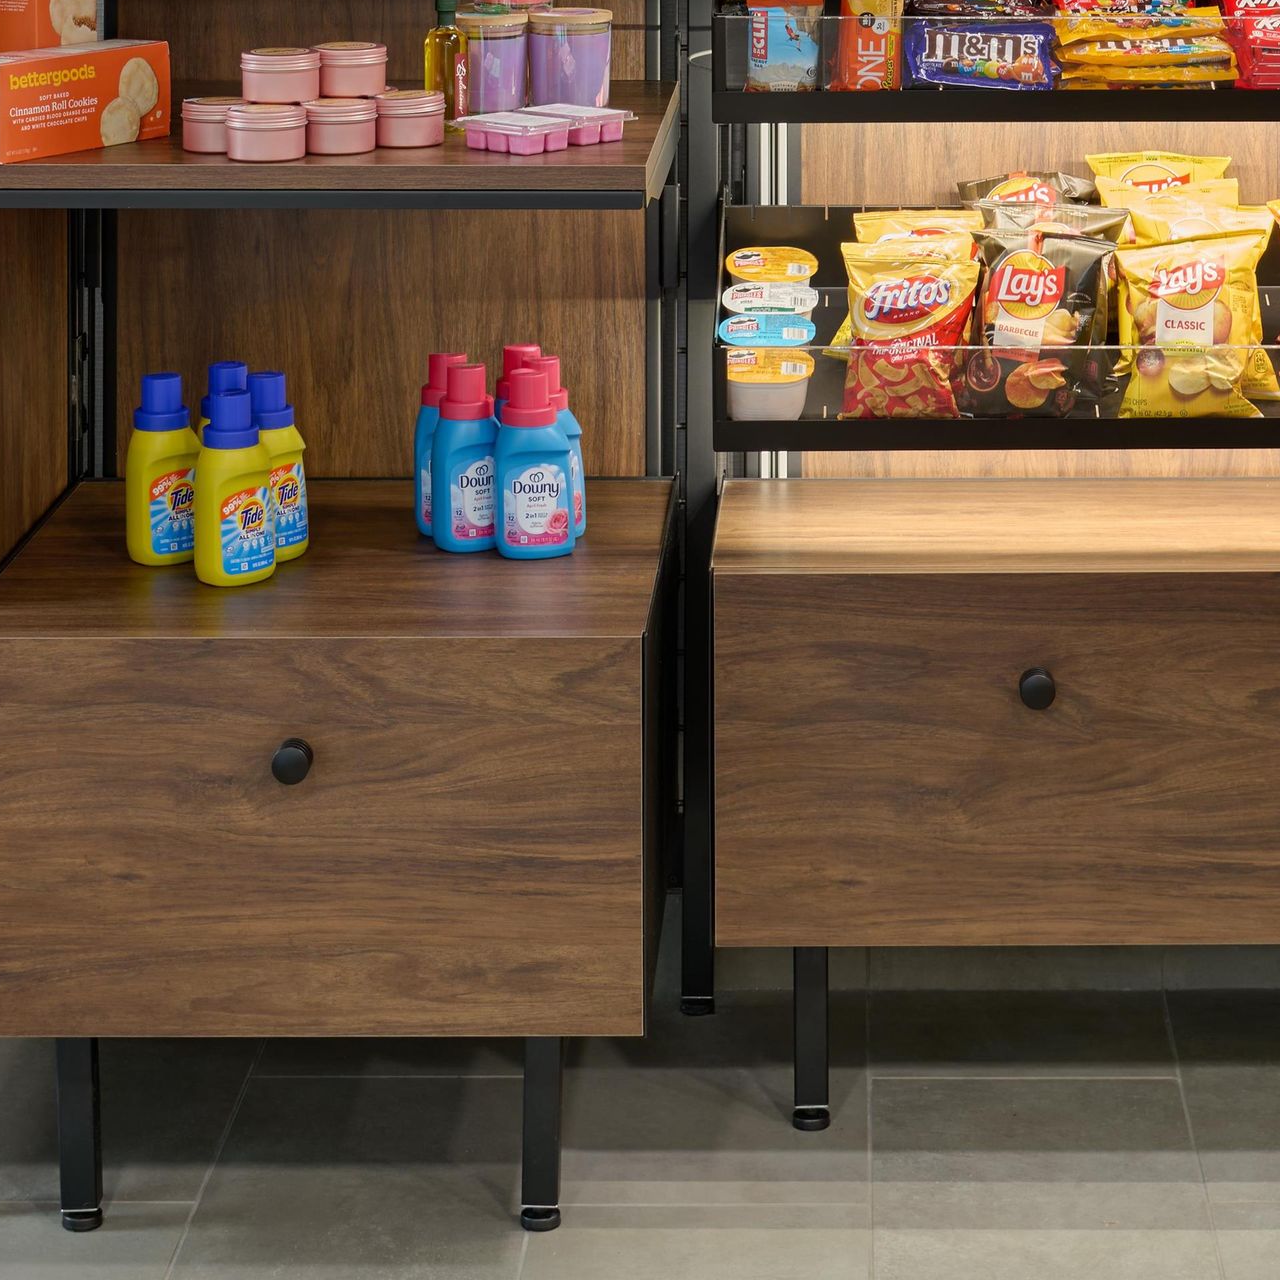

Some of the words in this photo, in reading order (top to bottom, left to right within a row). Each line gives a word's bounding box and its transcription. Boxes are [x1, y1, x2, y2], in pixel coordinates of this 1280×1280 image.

[9, 64, 97, 90] bettergoods
[9, 105, 50, 117] Cinnamon
[51, 101, 67, 111] Roll
[68, 96, 98, 107] Cookies
[12, 117, 26, 125] WITH
[27, 115, 46, 123] CANDIED
[46, 112, 63, 120] BLOOD
[63, 110, 81, 118] ORANGE
[82, 107, 96, 115] GLAZE
[31, 122, 46, 130] WHITE
[46, 119, 73, 128] CHOCOLATE
[73, 115, 88, 123] CHIPS
[997, 265, 1058, 306] Lay's
[1158, 259, 1220, 295] Lay's
[732, 291, 763, 299] PRINGLES
[864, 279, 952, 320] Fritos
[893, 311, 920, 319] BRAND
[998, 324, 1040, 338] BARBECUE
[1164, 319, 1206, 331] CLASSIC
[278, 481, 298, 505] Tide
[513, 480, 560, 497] Downy
[171, 486, 194, 511] Tide
[222, 497, 242, 515] 99%
[241, 506, 263, 531] Tide
